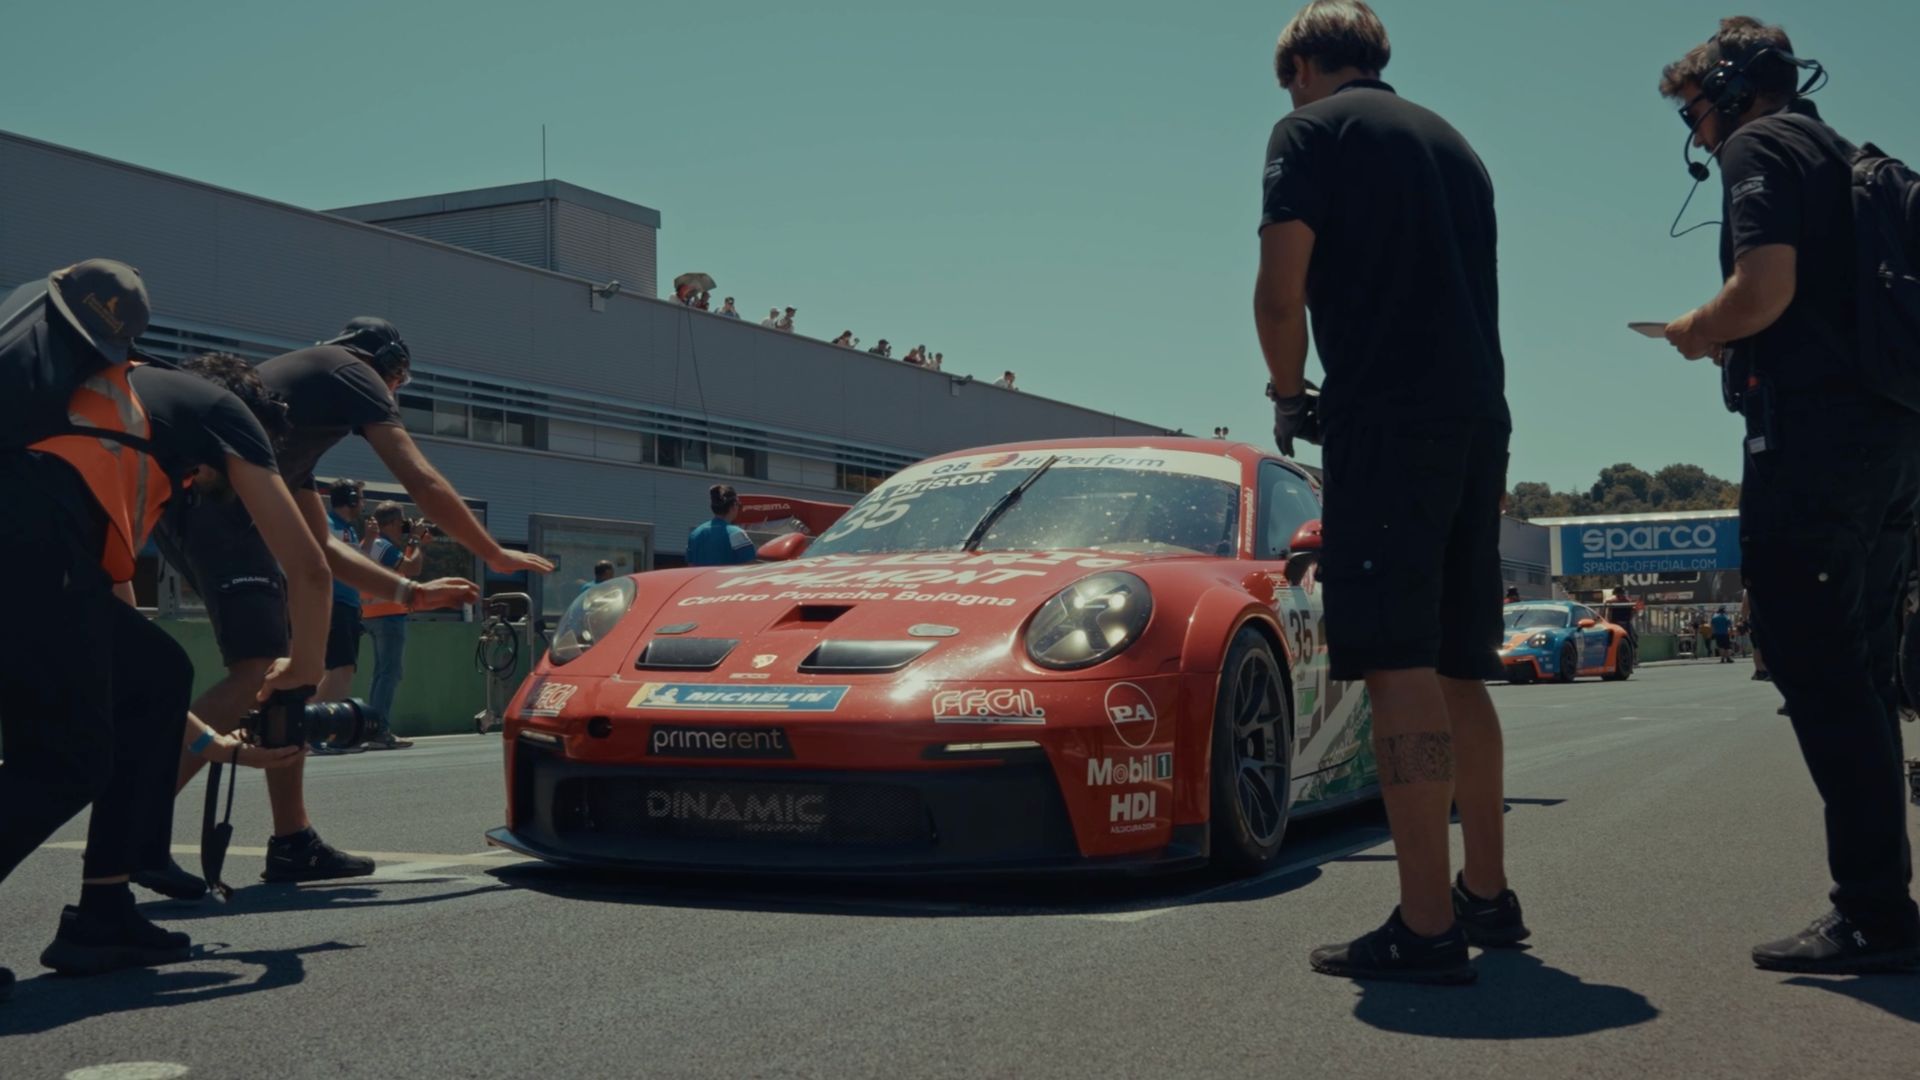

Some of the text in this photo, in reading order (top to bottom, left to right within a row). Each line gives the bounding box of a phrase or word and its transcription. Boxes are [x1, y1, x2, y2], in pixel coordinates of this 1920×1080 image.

[932, 461, 971, 475] Q8
[890, 471, 997, 497] Bristot
[823, 491, 924, 543] 35
[1582, 525, 1717, 559] sparco
[716, 567, 1048, 588] VALMONT
[1582, 558, 1717, 573] SPARCO-OFFICIAL.COM
[677, 590, 1017, 606] Centro Porsche Bologna
[1289, 610, 1314, 666] 35
[685, 689, 828, 704] MICHELIN
[1110, 704, 1154, 723] PA
[652, 728, 783, 753] primerent
[1087, 754, 1153, 785] Mobil
[646, 790, 827, 823] DINAMIC
[1110, 791, 1156, 822] HDI
